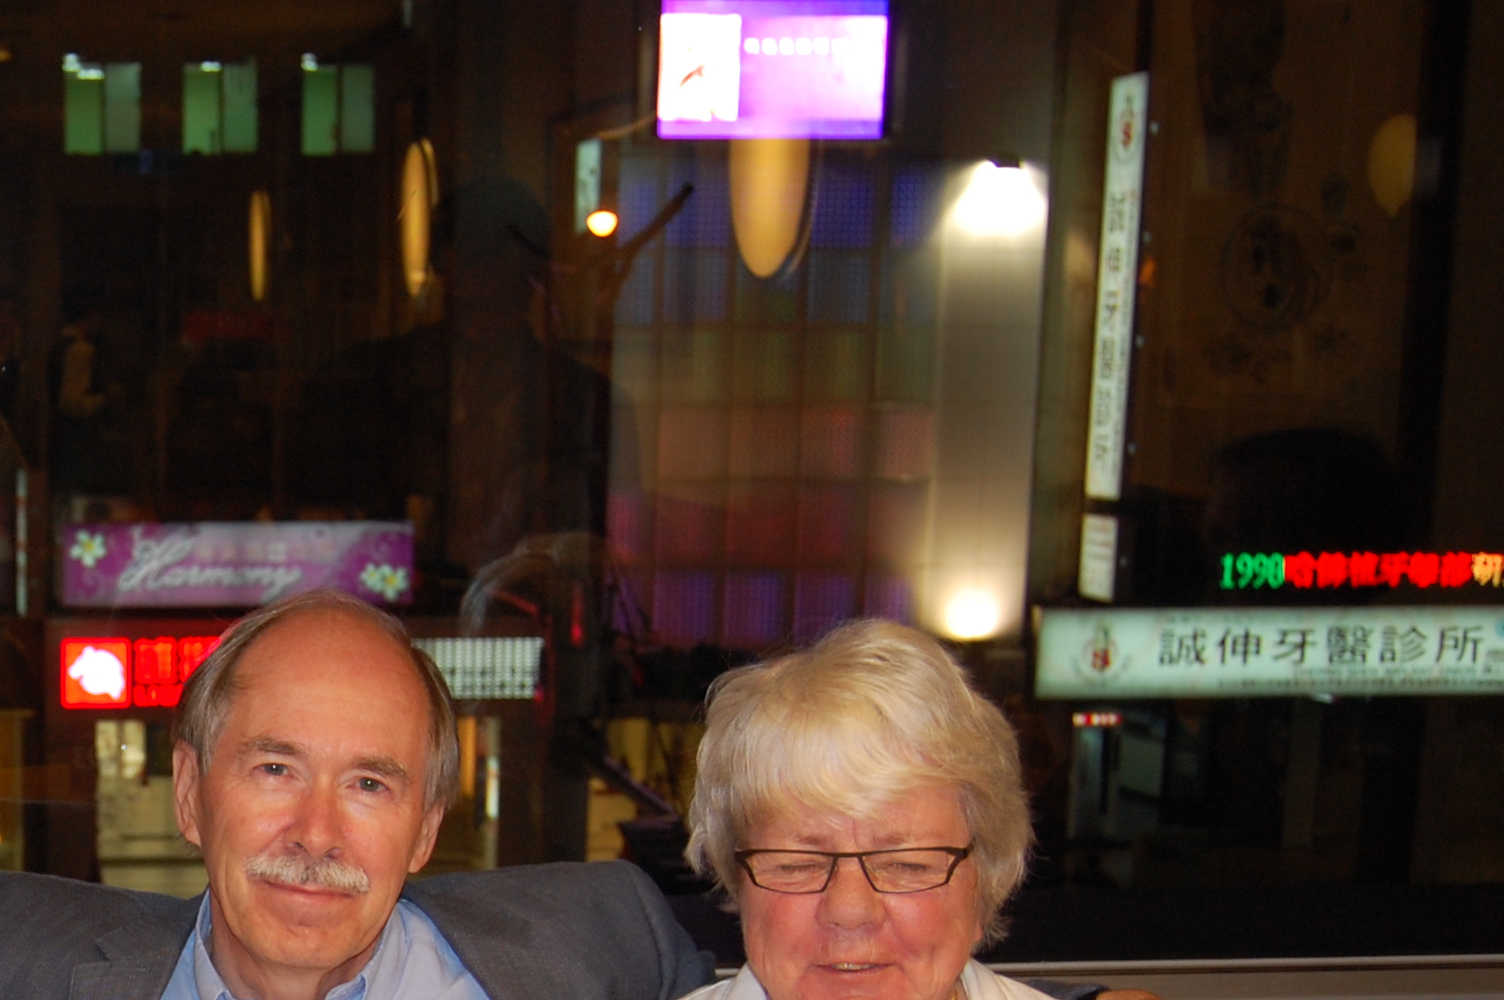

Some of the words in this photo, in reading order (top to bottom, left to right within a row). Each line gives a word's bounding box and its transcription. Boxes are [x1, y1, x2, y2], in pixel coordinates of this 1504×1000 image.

[117, 529, 304, 602] Harmony
[1158, 624, 1485, 667] 誠伸牙醫診所
